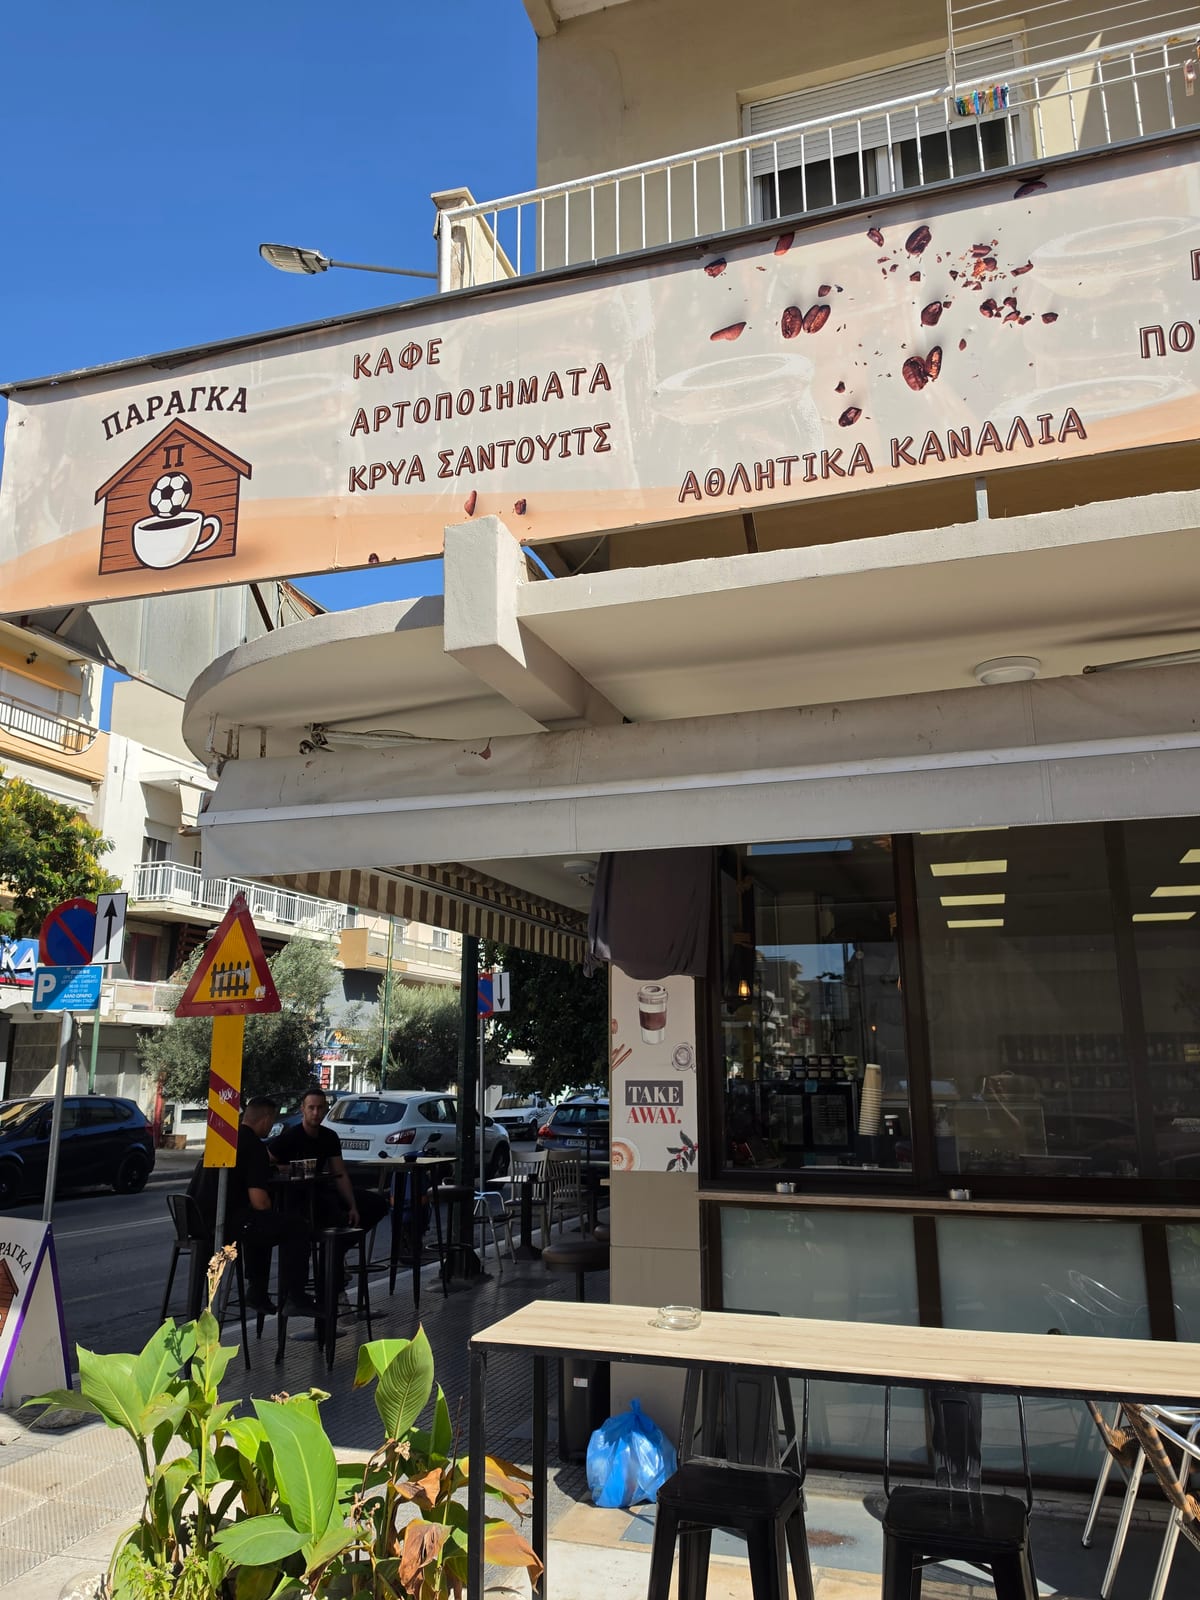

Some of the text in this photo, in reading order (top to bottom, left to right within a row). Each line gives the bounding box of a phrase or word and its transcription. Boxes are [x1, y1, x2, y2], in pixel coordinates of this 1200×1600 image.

[353, 338, 442, 379] ΚΑΦΕ
[1140, 320, 1200, 359] ΠΟ
[101, 386, 248, 441] ΠΑΡΑΓΚΑ
[350, 362, 611, 437] ΑΡΤΟΠΟΙΗΜΑΤΑ
[162, 443, 185, 469] Π
[348, 422, 611, 492] ΚΡΥΑ ΣΑΝΤΟΥΙΤΣ
[678, 407, 1088, 502] ΑΘΛΗΤΙΚΑ ΚΑΝΑΛΙΑ
[36, 973, 57, 1002] P
[628, 1086, 680, 1104] TAKE
[626, 1107, 682, 1124] AWAY.
